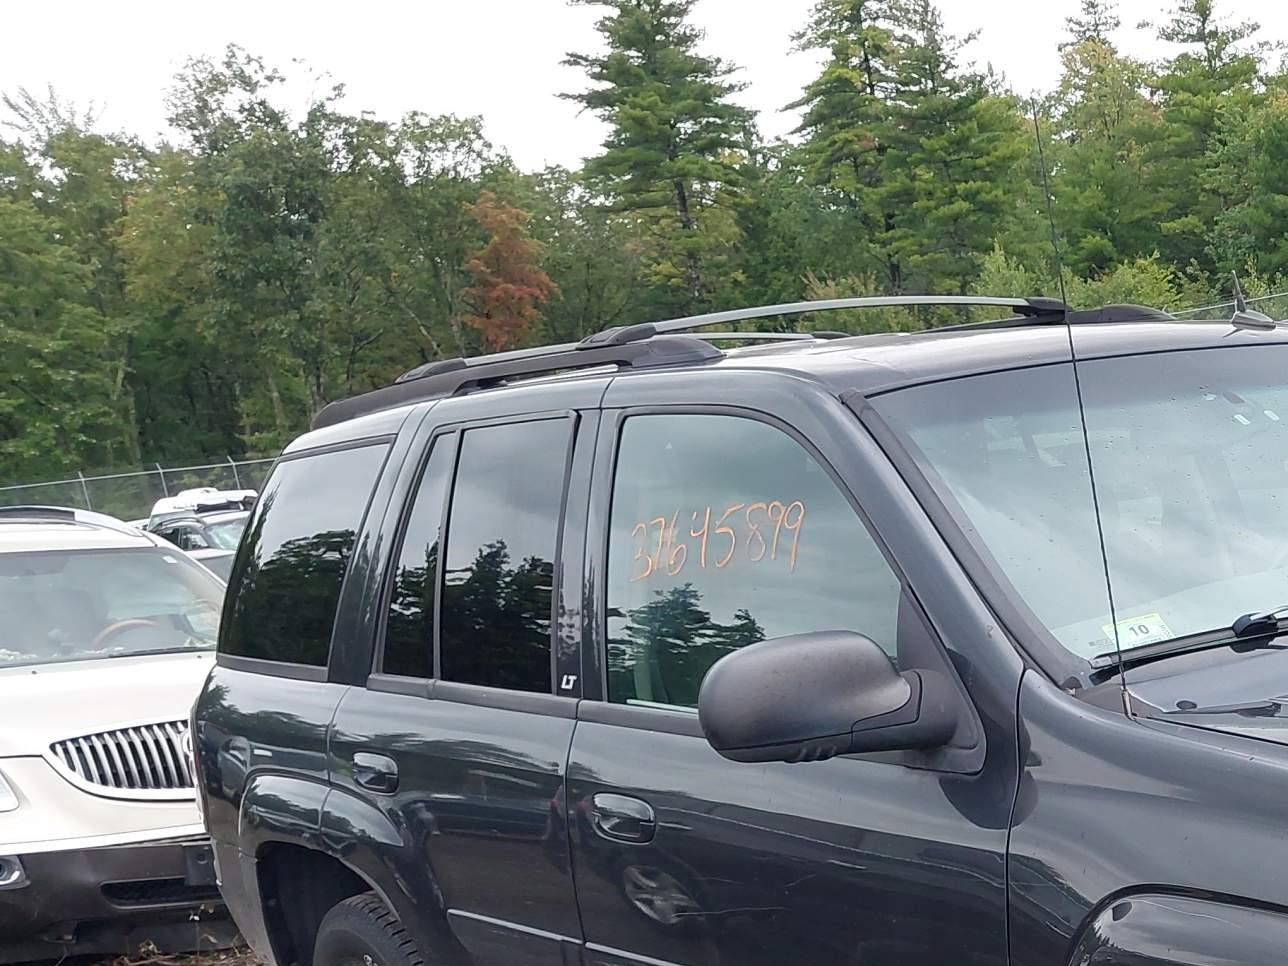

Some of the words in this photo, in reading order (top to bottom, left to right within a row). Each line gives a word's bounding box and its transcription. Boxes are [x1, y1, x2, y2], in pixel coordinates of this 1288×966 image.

[630, 500, 805, 582] 37645899
[1128, 624, 1151, 637] 10
[561, 674, 578, 690] LT
